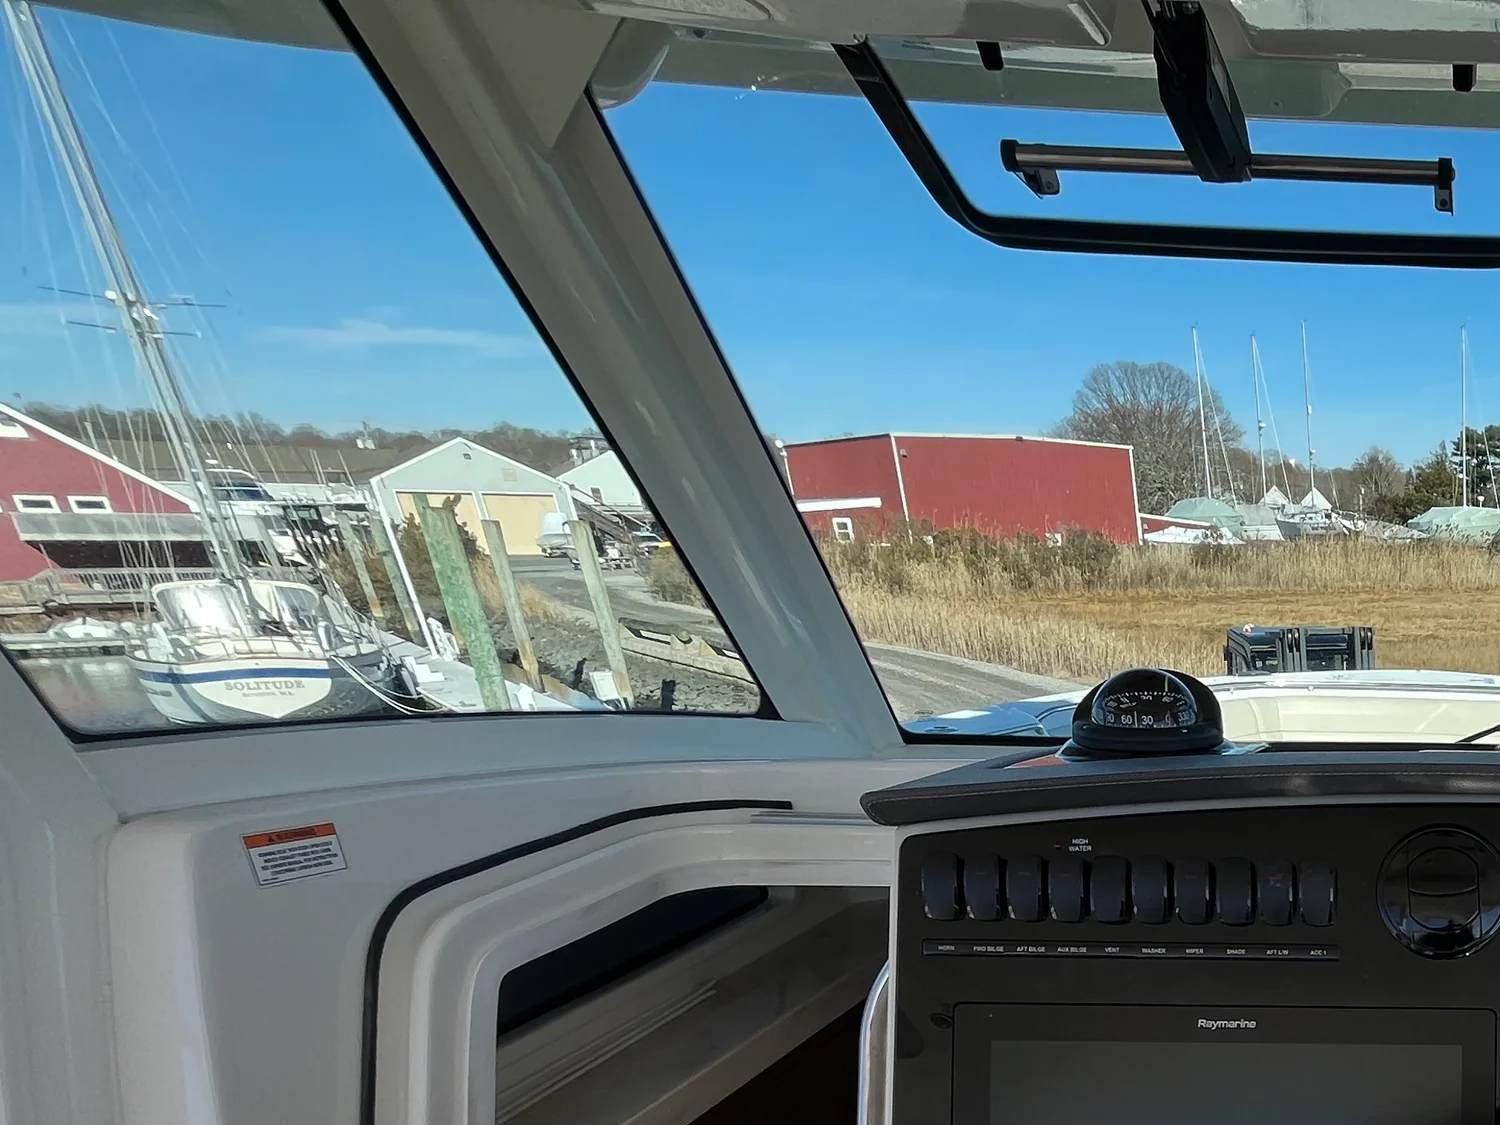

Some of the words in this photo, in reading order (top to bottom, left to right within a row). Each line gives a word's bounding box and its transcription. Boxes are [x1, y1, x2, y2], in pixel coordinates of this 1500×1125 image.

[224, 680, 305, 691] SOLITUDE
[1121, 715, 1132, 724] 60
[1142, 716, 1154, 725] 30
[1198, 1019, 1256, 1030] Raymarine
